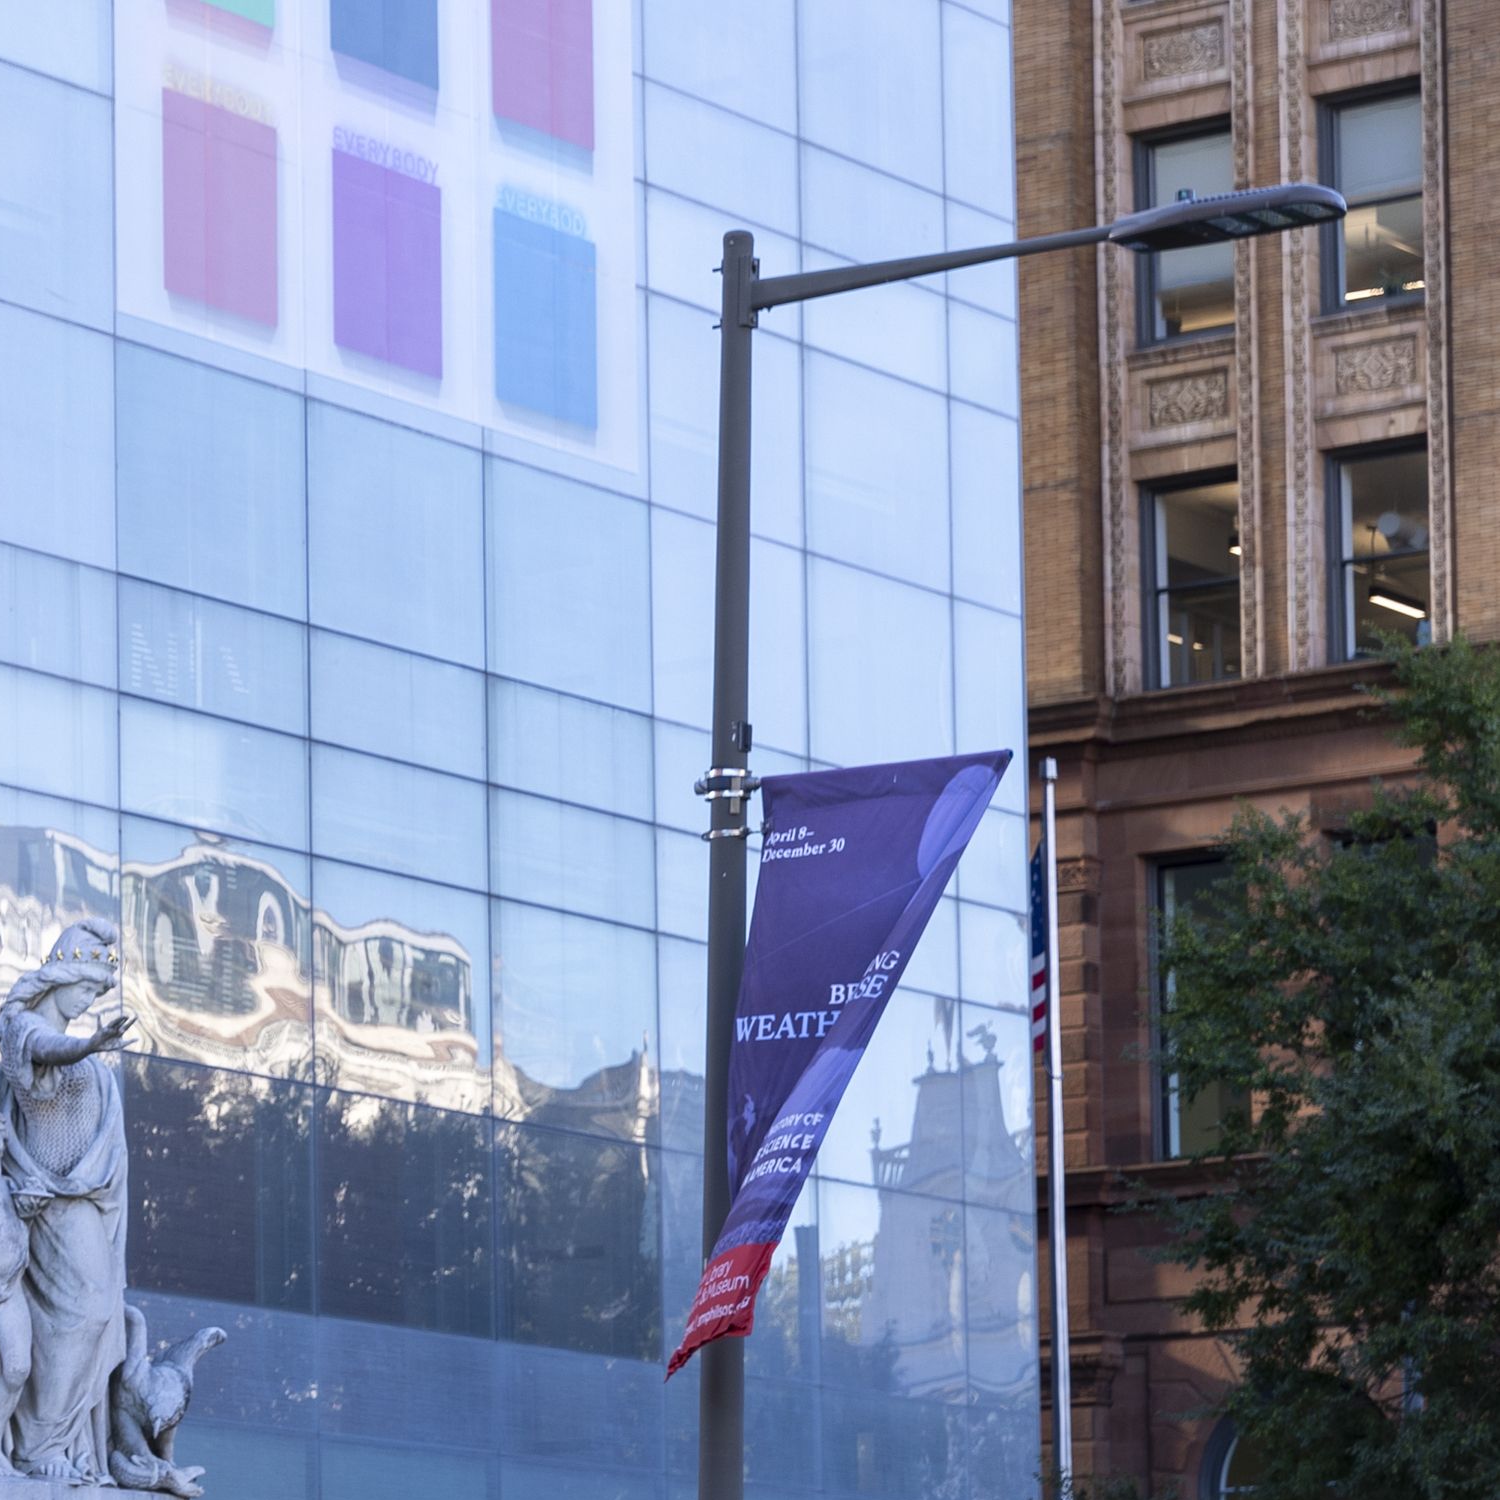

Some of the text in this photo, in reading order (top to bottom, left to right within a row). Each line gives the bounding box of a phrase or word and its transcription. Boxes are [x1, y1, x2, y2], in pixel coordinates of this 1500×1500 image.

[332, 125, 440, 187] EVERYBODY
[766, 827, 796, 846] April
[762, 837, 846, 863] December 30
